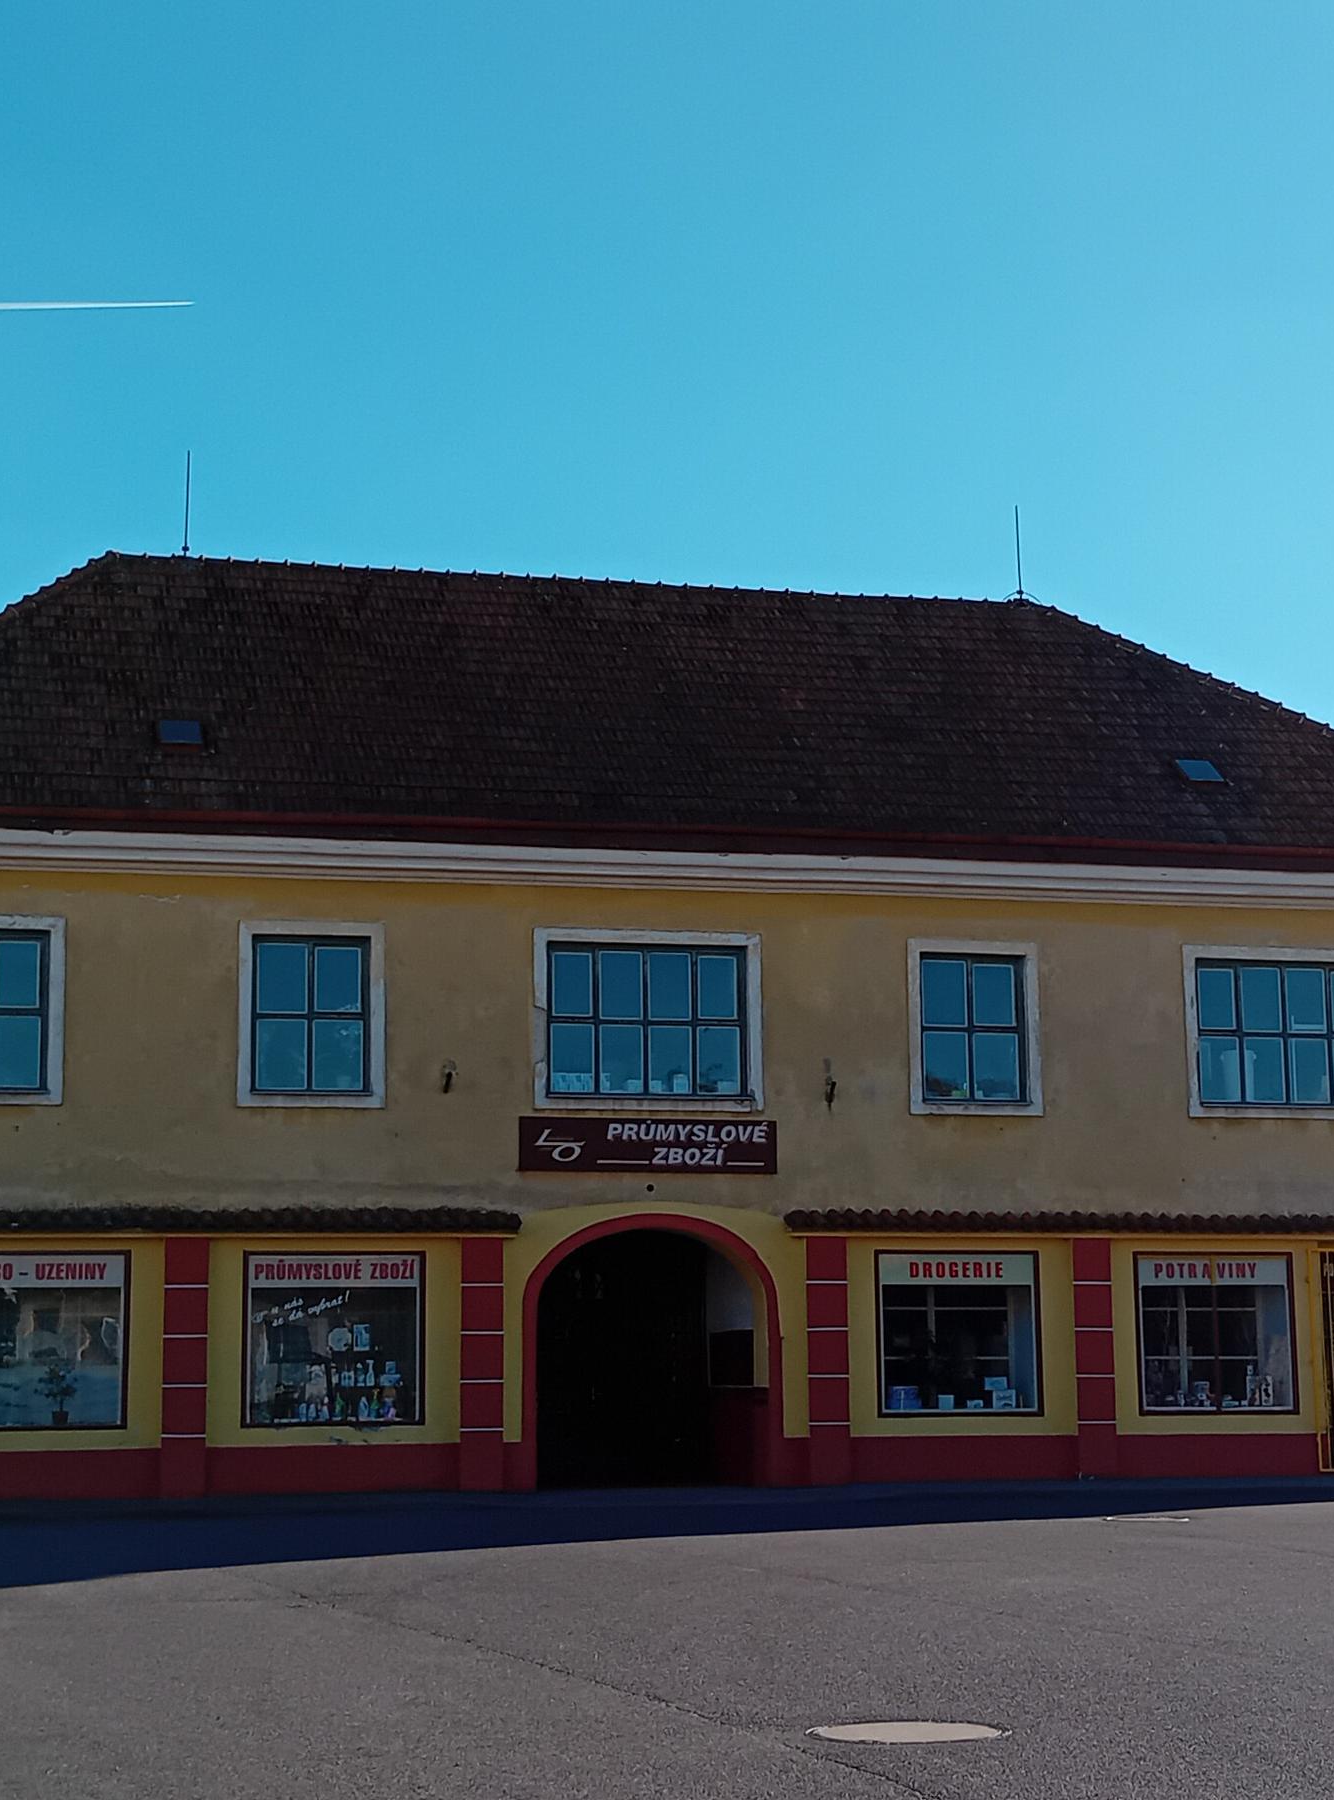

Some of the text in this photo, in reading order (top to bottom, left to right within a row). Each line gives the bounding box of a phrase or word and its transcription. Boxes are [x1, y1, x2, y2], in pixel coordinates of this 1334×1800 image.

[606, 1120, 770, 1143] PRŮMYSLOVÉ
[651, 1144, 728, 1165] ZBOŽÍ
[35, 1262, 107, 1280] UZENINY
[254, 1259, 415, 1280] PRŮMYSLOVÉ ZBOŽÍ
[909, 1262, 1003, 1278] DROGERIE
[1154, 1262, 1257, 1279] POTRAVINY
